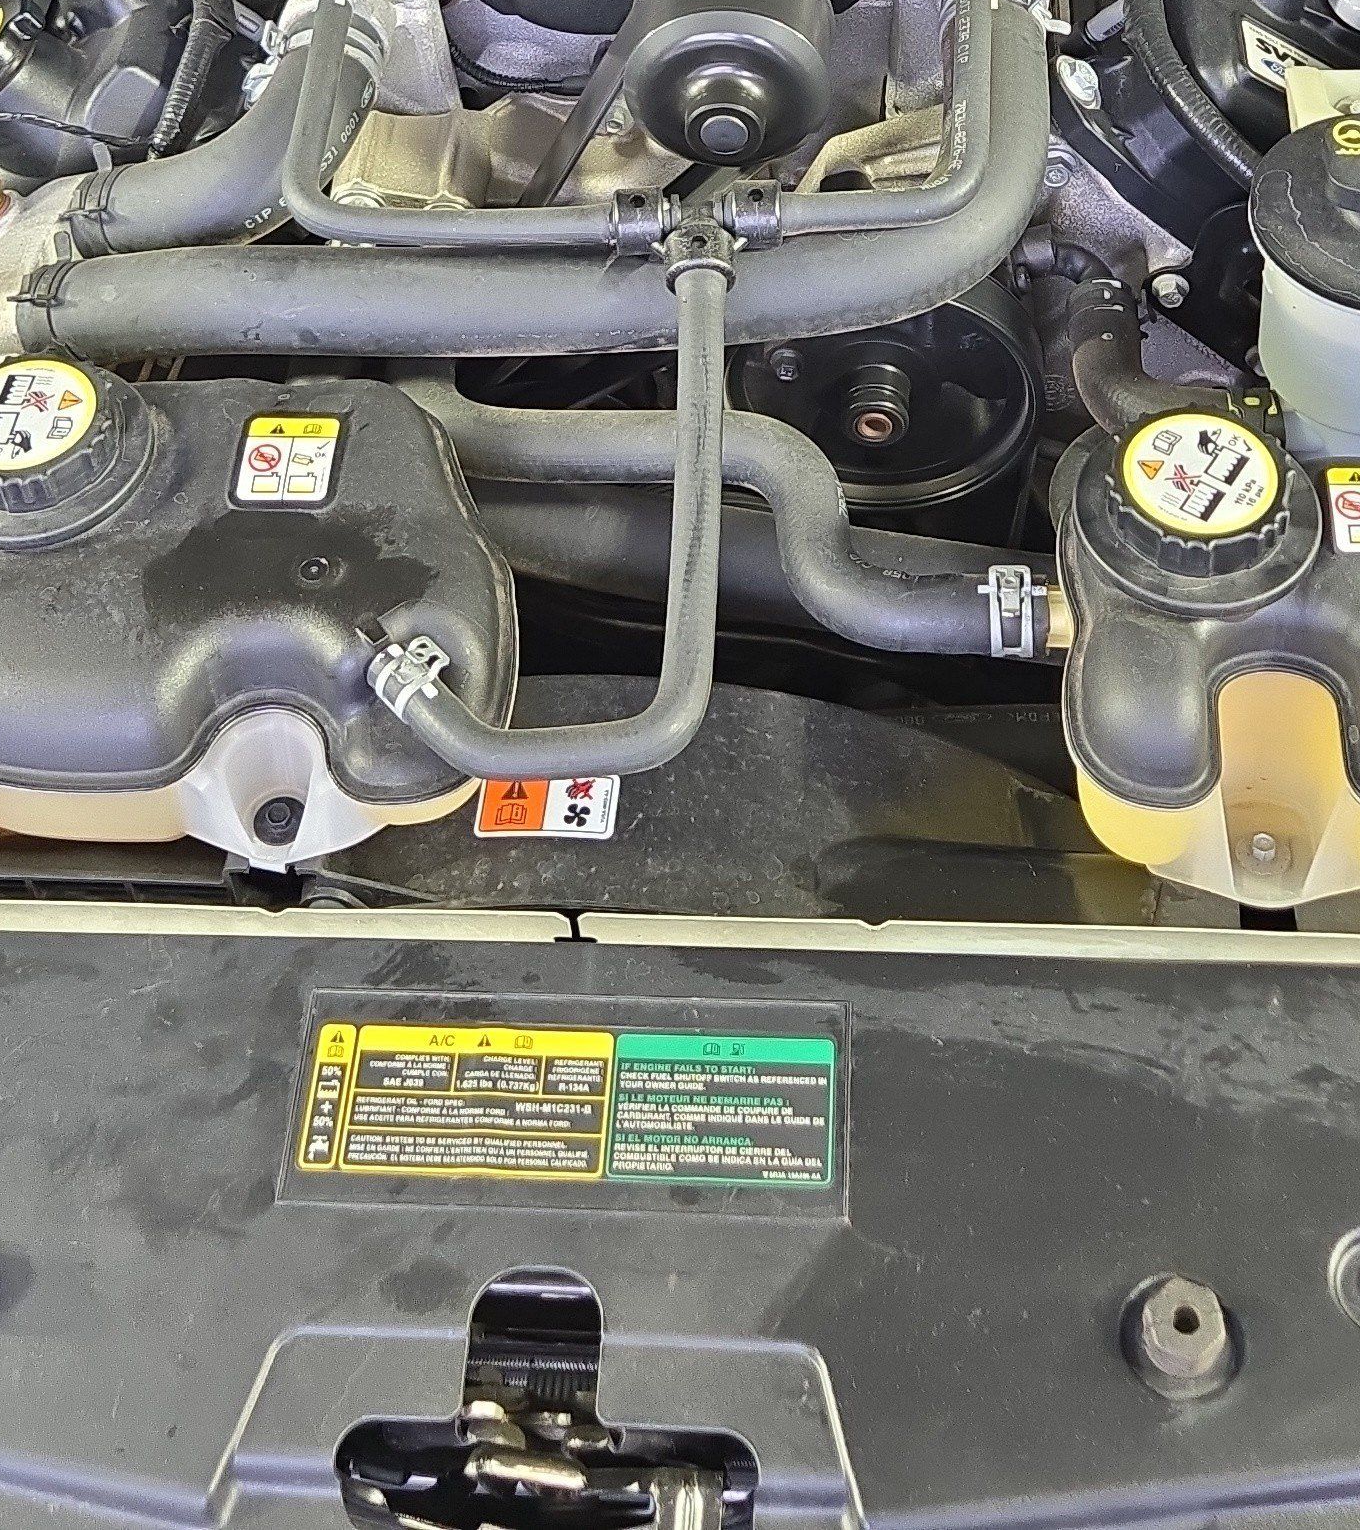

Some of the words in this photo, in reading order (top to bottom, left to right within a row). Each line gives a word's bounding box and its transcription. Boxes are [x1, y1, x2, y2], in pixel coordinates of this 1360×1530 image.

[1228, 434, 1241, 447] OK
[1235, 491, 1248, 505] 110
[1244, 479, 1257, 493] kPa
[429, 1034, 455, 1046] A/C
[322, 1066, 341, 1076] 50%
[621, 1062, 632, 1070] IF
[634, 1063, 672, 1071] ENGINE
[674, 1064, 701, 1072] FAILS
[704, 1065, 718, 1073] TO
[383, 1077, 401, 1086] SAE
[620, 1071, 649, 1080] CHECK
[650, 1073, 672, 1081] FUEL
[674, 1074, 712, 1082] SHUTOFF
[714, 1074, 746, 1083] SWITCH
[747, 1075, 759, 1084] AS
[760, 1076, 816, 1085] REFERENCED
[818, 1077, 828, 1086] IN
[620, 1080, 643, 1088] YOUR
[645, 1081, 676, 1089] OWNER
[619, 1094, 629, 1102] SI
[631, 1094, 644, 1102] LE
[647, 1094, 690, 1103] MOTEUR
[693, 1095, 707, 1103] NE
[763, 1097, 783, 1106] PAS
[658, 1104, 670, 1112] LA
[671, 1104, 721, 1113] COMMANDE
[723, 1106, 735, 1114] DE
[738, 1106, 779, 1115] COUPURE
[313, 1116, 333, 1127] 50%
[674, 1113, 706, 1122] COMME
[745, 1115, 769, 1124] DANS
[771, 1116, 782, 1124] LE
[784, 1116, 811, 1125] GUIDE
[615, 1134, 625, 1142] SI
[628, 1134, 640, 1142] EL
[644, 1134, 681, 1144] MOTOR
[684, 1136, 698, 1144] NO
[614, 1143, 646, 1152] REVISE
[648, 1144, 659, 1152] EL
[660, 1144, 724, 1154] INTERRUPTOR
[725, 1146, 737, 1154] DE
[739, 1146, 773, 1156] CIERRE
[774, 1148, 792, 1156] DEL
[614, 1152, 676, 1162] COMBUSTIBLE
[679, 1154, 706, 1163] COMO
[722, 1155, 752, 1165] INDICA
[753, 1156, 766, 1165] EN
[767, 1157, 780, 1166] LA
[804, 1158, 822, 1167] DEL
